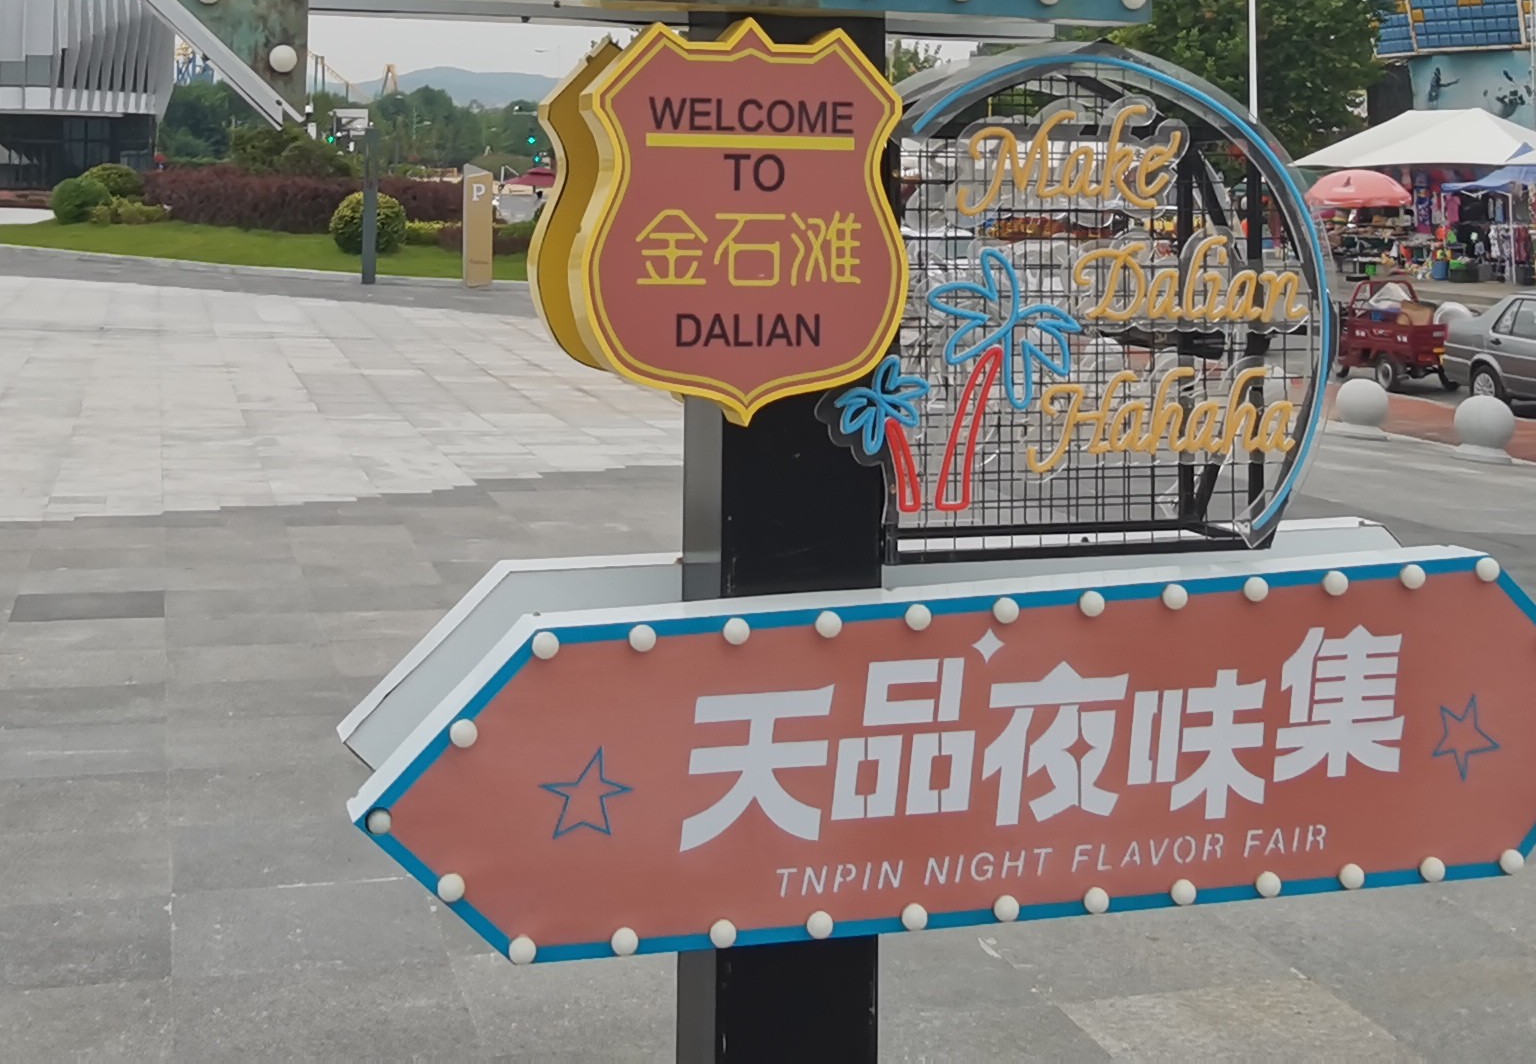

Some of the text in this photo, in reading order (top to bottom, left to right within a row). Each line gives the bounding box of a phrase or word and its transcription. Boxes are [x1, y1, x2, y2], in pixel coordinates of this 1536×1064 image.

[648, 96, 856, 135] WELCOME
[471, 183, 486, 202] P
[724, 153, 786, 193] TO
[957, 104, 1182, 217] Make
[635, 209, 862, 287] 金石滩
[1073, 235, 1309, 322] Dalian
[675, 313, 821, 349] DALIAN
[1026, 366, 1296, 474] Hahaha
[679, 626, 1405, 853] 天品夜味集
[776, 823, 1328, 898] TNPIN NIGHT FLAVOR FAIR
